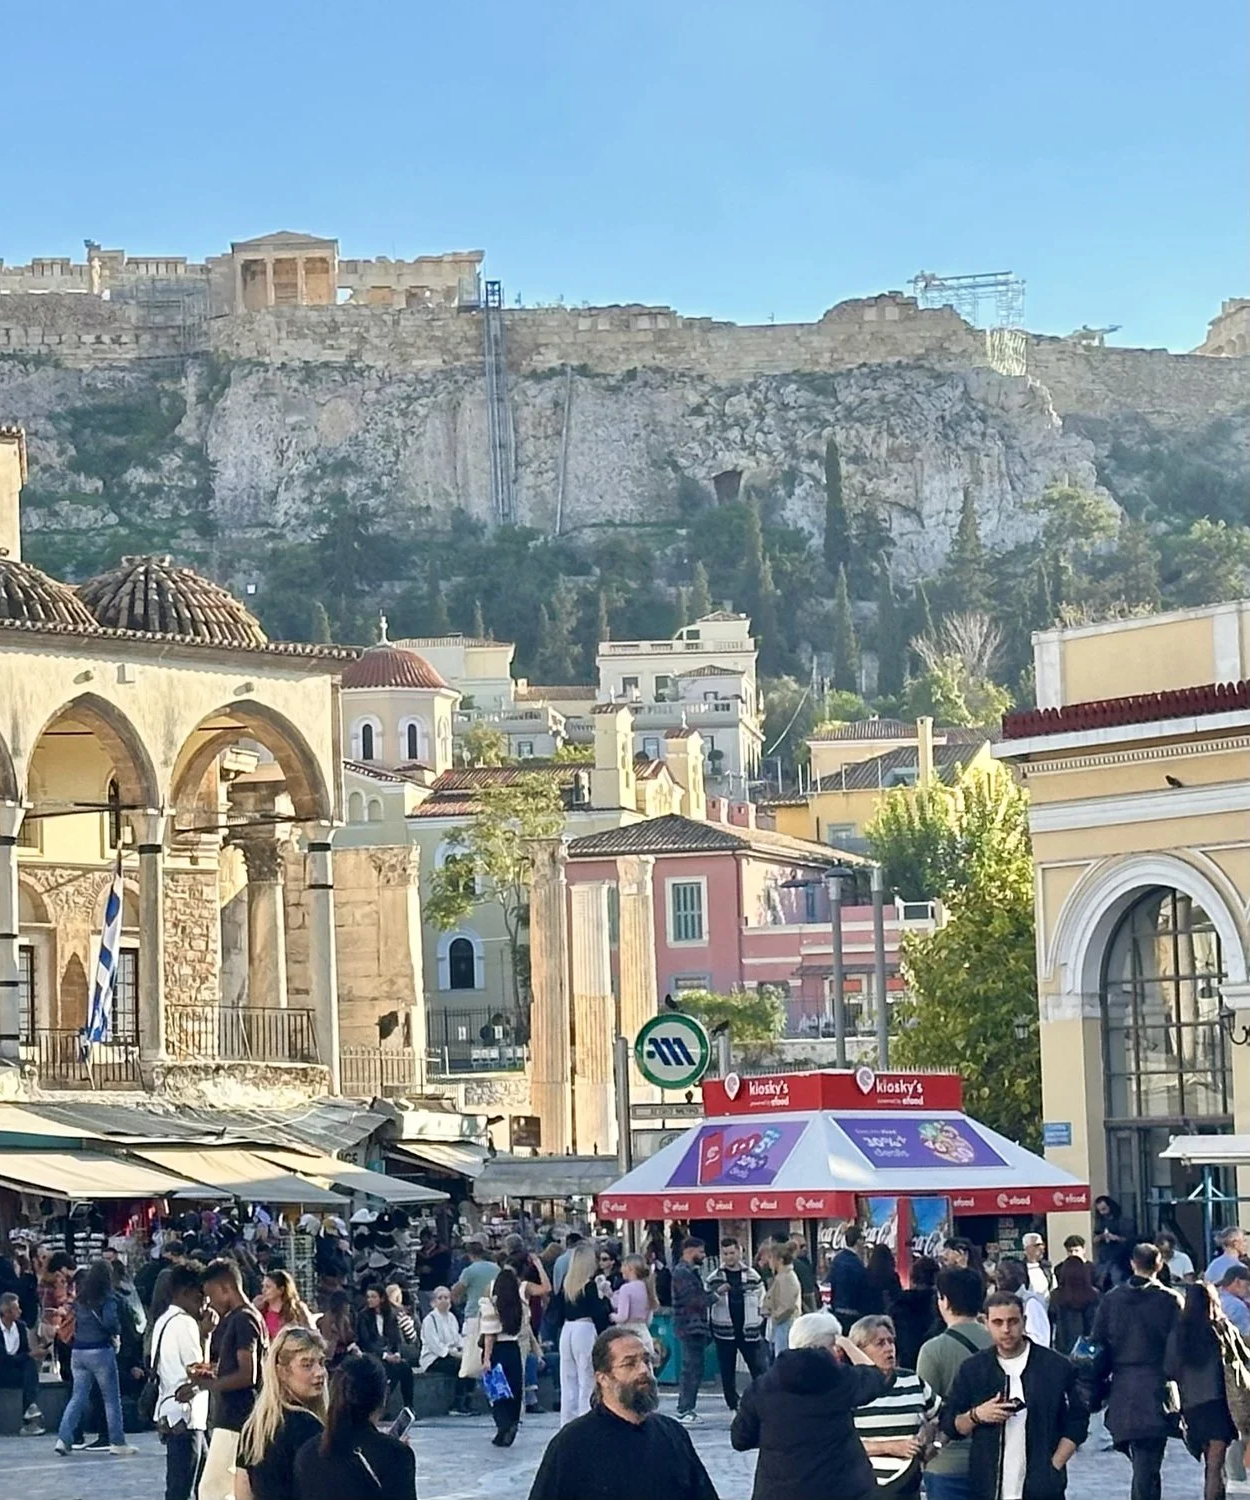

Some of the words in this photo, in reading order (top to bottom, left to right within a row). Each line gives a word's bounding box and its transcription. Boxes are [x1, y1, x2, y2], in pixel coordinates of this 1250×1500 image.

[749, 1080, 790, 1096] kiosky's
[876, 1078, 924, 1095] kiosky's
[771, 1096, 790, 1106] efood
[903, 1095, 924, 1106] efood
